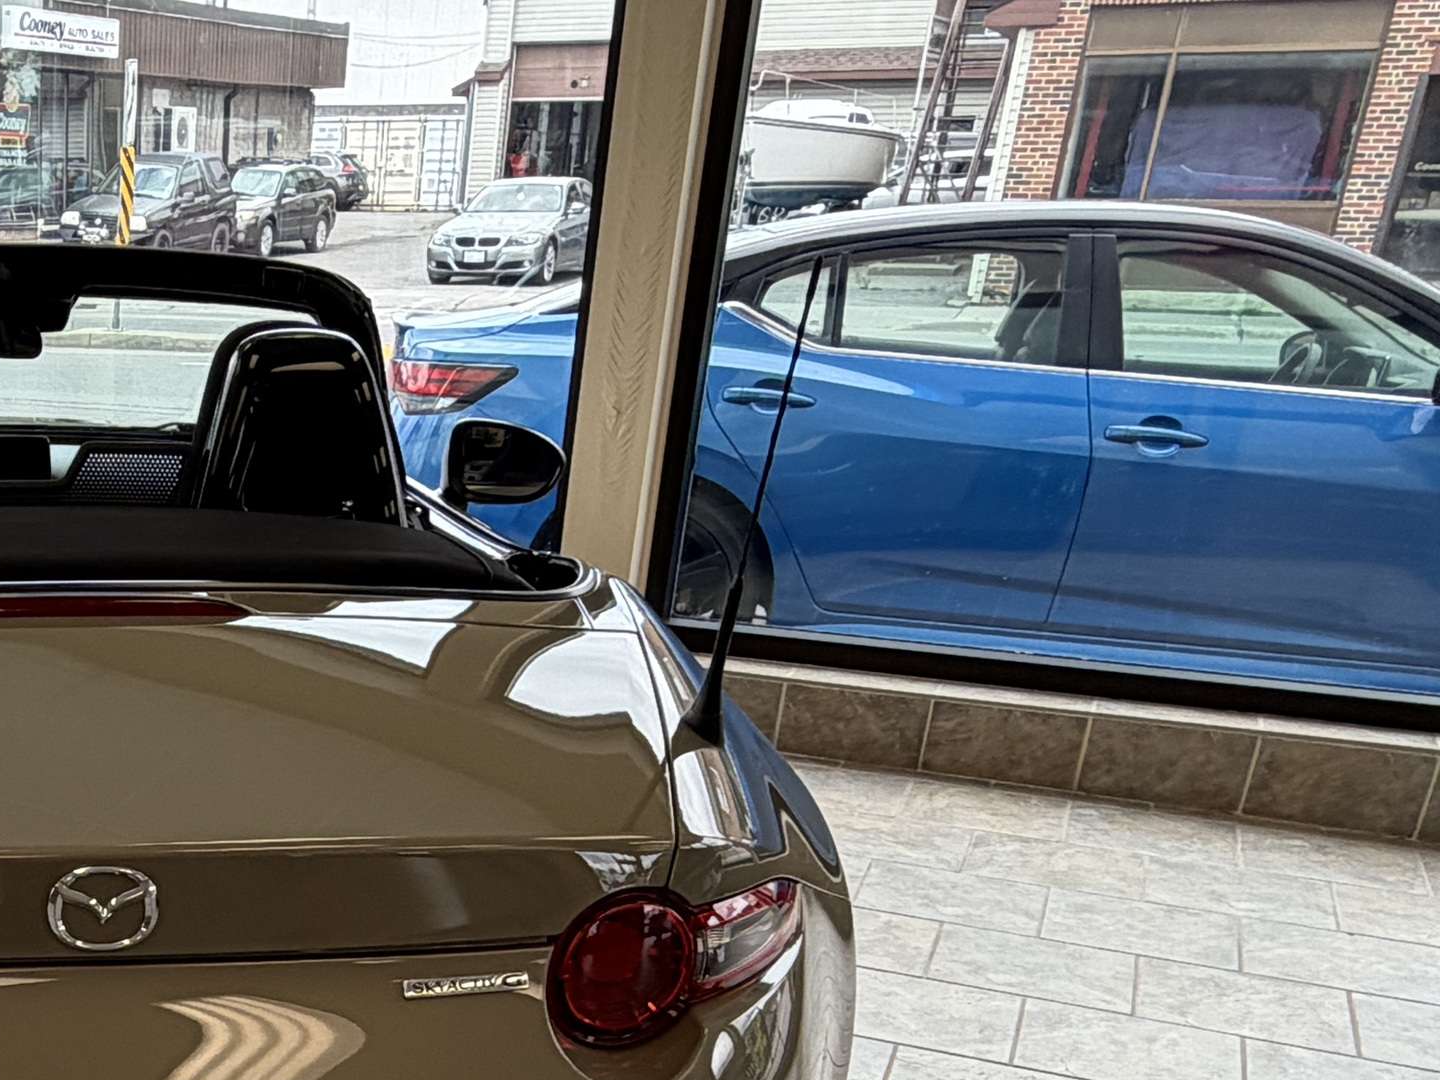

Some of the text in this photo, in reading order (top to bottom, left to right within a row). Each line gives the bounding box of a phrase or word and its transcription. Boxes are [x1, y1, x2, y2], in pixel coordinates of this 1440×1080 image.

[19, 11, 116, 42] Cooney AUTO SALES
